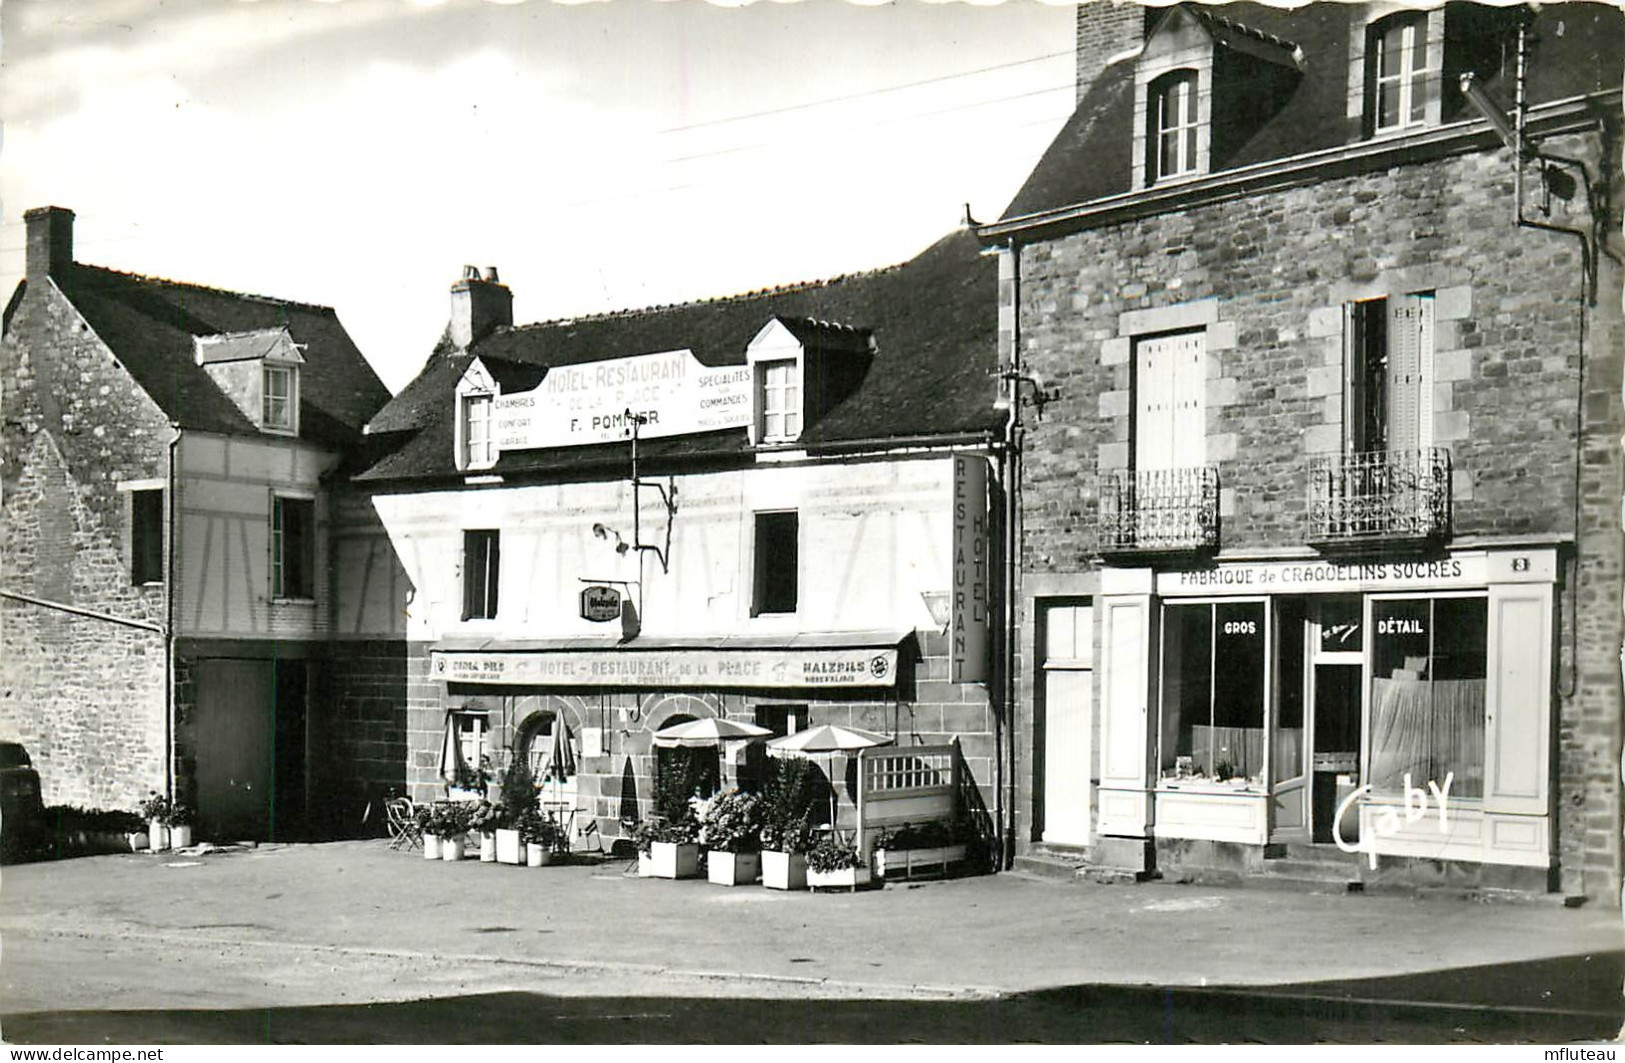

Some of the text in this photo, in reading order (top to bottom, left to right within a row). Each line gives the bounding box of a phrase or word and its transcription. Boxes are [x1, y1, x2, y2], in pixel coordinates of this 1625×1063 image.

[495, 397, 535, 410] CHAMBRES
[498, 418, 531, 429] CONFORT
[570, 418, 583, 432] F.
[955, 459, 966, 679] RESTAURANT
[973, 516, 984, 622] HOTEL
[1516, 559, 1525, 570] 3
[1180, 569, 1253, 586] FABRIQUE
[1259, 569, 1275, 584] de
[1281, 565, 1387, 582] CRAQUELINS
[1224, 621, 1256, 634] GROS
[540, 662, 575, 676] HOTEL
[591, 660, 670, 676] RESTAURANT
[680, 665, 691, 675] DE
[698, 665, 708, 675] LA
[718, 661, 761, 676] PLACE
